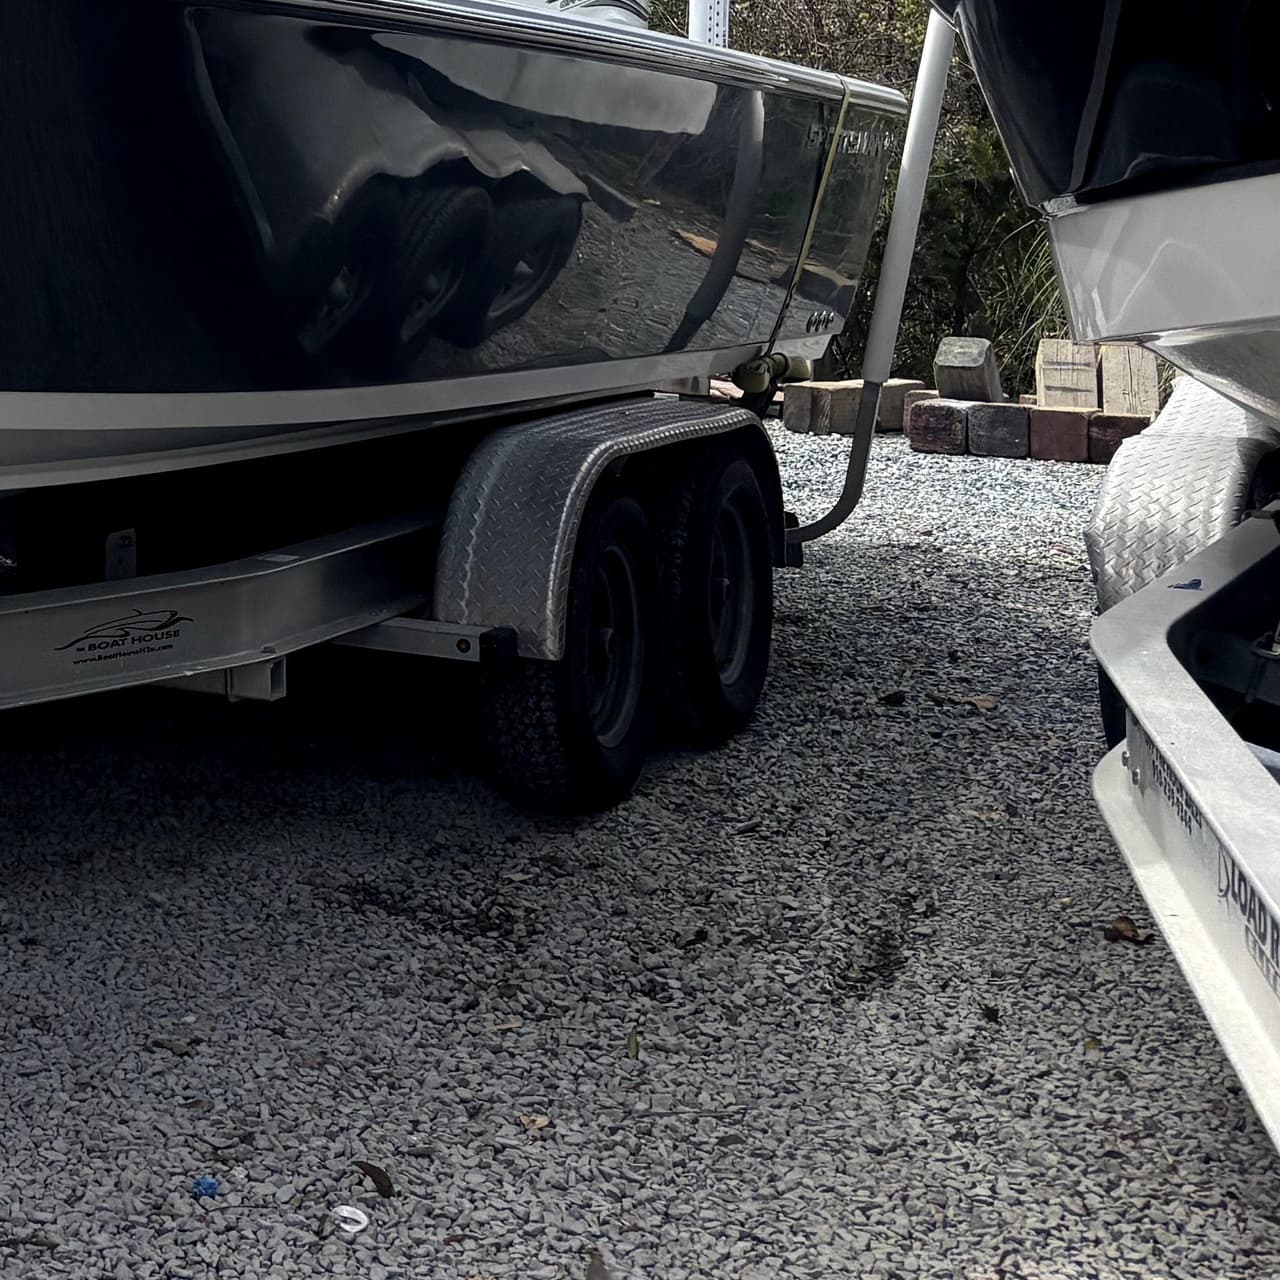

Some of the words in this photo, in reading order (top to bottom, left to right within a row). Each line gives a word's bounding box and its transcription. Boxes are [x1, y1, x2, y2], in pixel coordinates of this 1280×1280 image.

[87, 638, 128, 652] BOAT
[130, 629, 181, 645] HOUSE
[1231, 857, 1268, 947] LOAD
